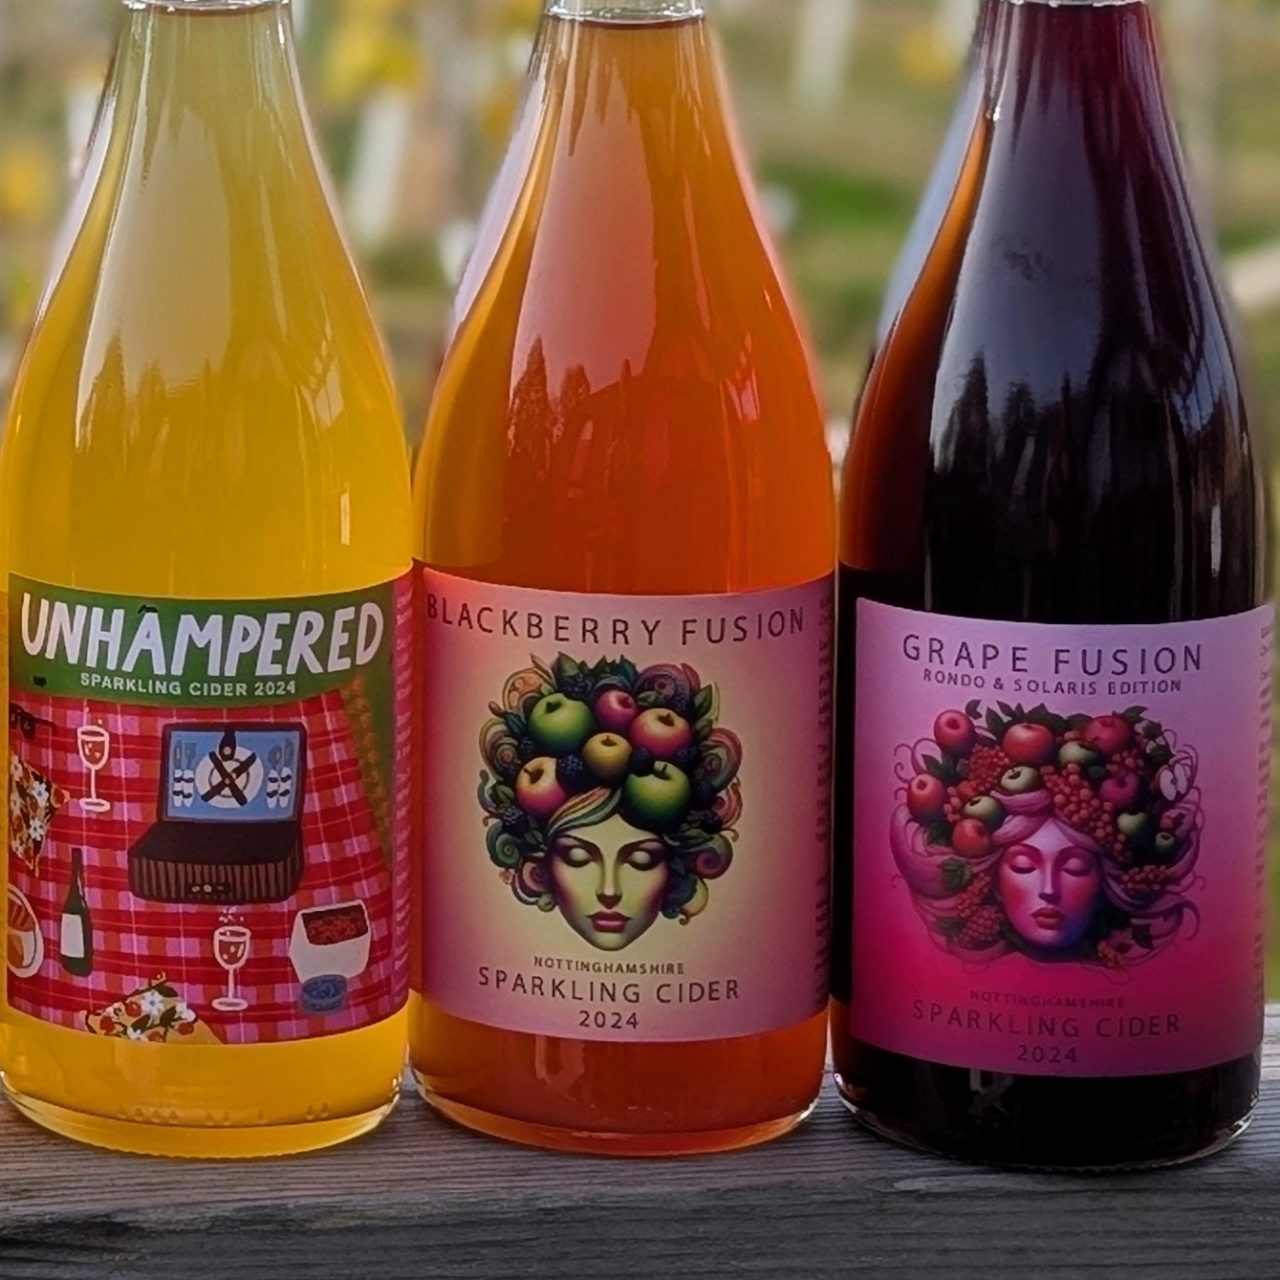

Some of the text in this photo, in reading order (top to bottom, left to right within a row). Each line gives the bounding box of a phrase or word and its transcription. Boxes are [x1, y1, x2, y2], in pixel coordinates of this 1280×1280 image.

[21, 592, 384, 677] UNHAMPERED
[426, 593, 662, 646] BLACKBERRY
[681, 606, 804, 645] FUSION
[902, 633, 1203, 676] GRAPE FUSION
[80, 672, 296, 697] SPARKLING CIDER 2024
[923, 668, 1181, 696] RONDO & SOLARIS EDITION
[534, 956, 684, 975] NOTTINGHAMSHIRE
[478, 966, 739, 1004] SPARKLING CIDER
[578, 1010, 639, 1030] 2024
[913, 1000, 1180, 1038] SPARKLING CIDER
[1017, 1044, 1077, 1064] 2024
